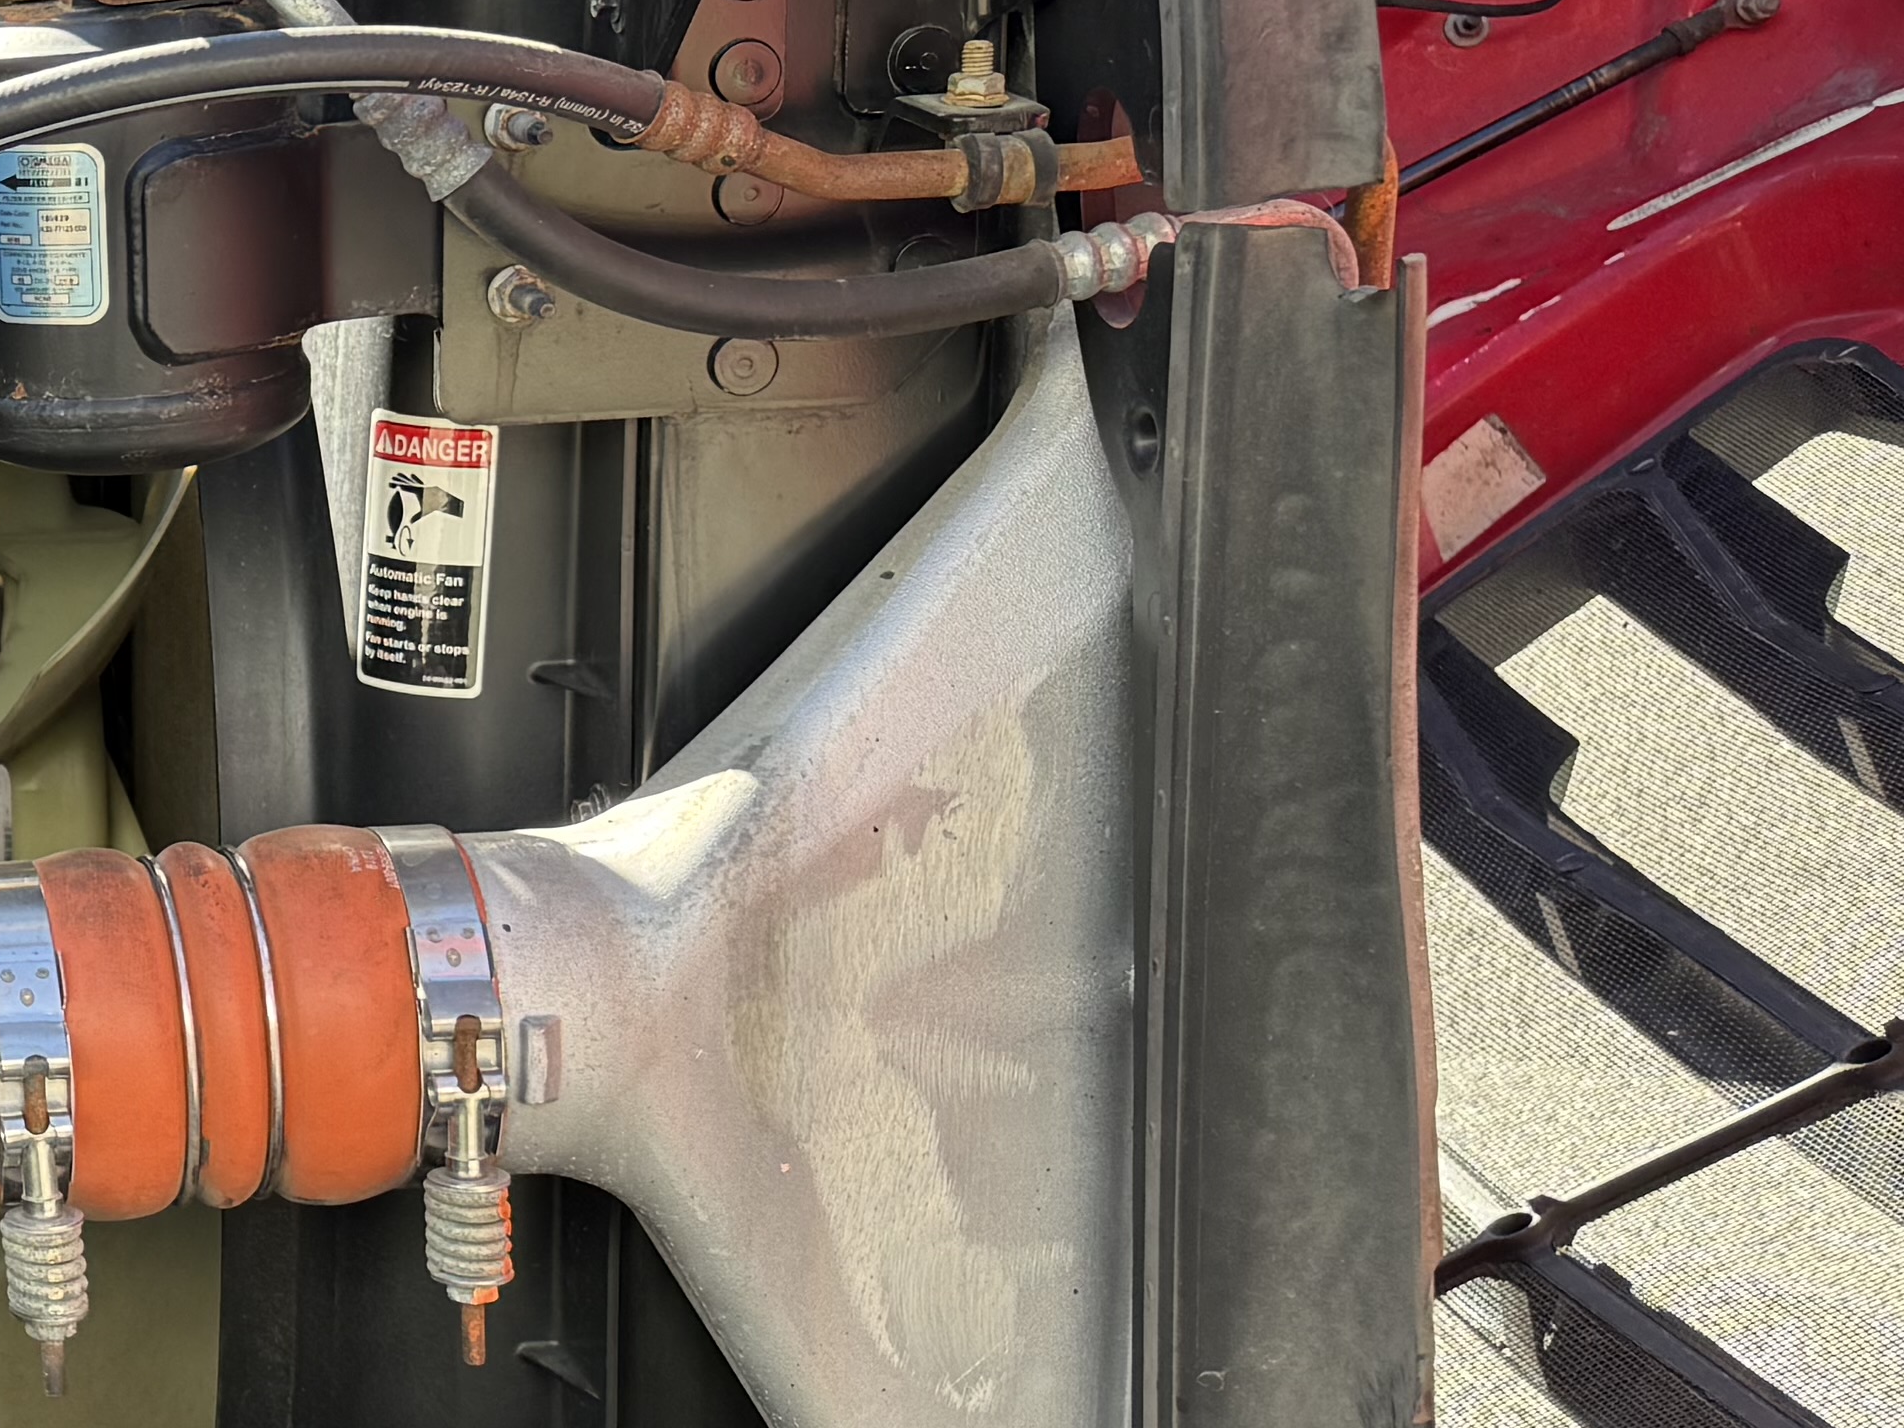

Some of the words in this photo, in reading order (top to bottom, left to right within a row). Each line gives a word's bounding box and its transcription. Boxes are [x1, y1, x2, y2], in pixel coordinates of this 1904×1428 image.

[554, 96, 610, 120] (10mm)
[394, 434, 488, 462] DANGER
[369, 563, 432, 585] Automatic
[435, 573, 464, 587] Fan
[368, 583, 392, 600] Keep
[393, 589, 430, 604] hands
[432, 594, 465, 606] clear
[367, 600, 392, 613] when
[393, 606, 433, 619] engine
[435, 608, 448, 620] is
[366, 613, 407, 632] running.
[364, 644, 376, 659] by
[376, 648, 407, 664] itself.
[365, 630, 382, 645] Fan
[382, 637, 416, 651] starts
[417, 642, 432, 652] or
[433, 643, 470, 657] stops
